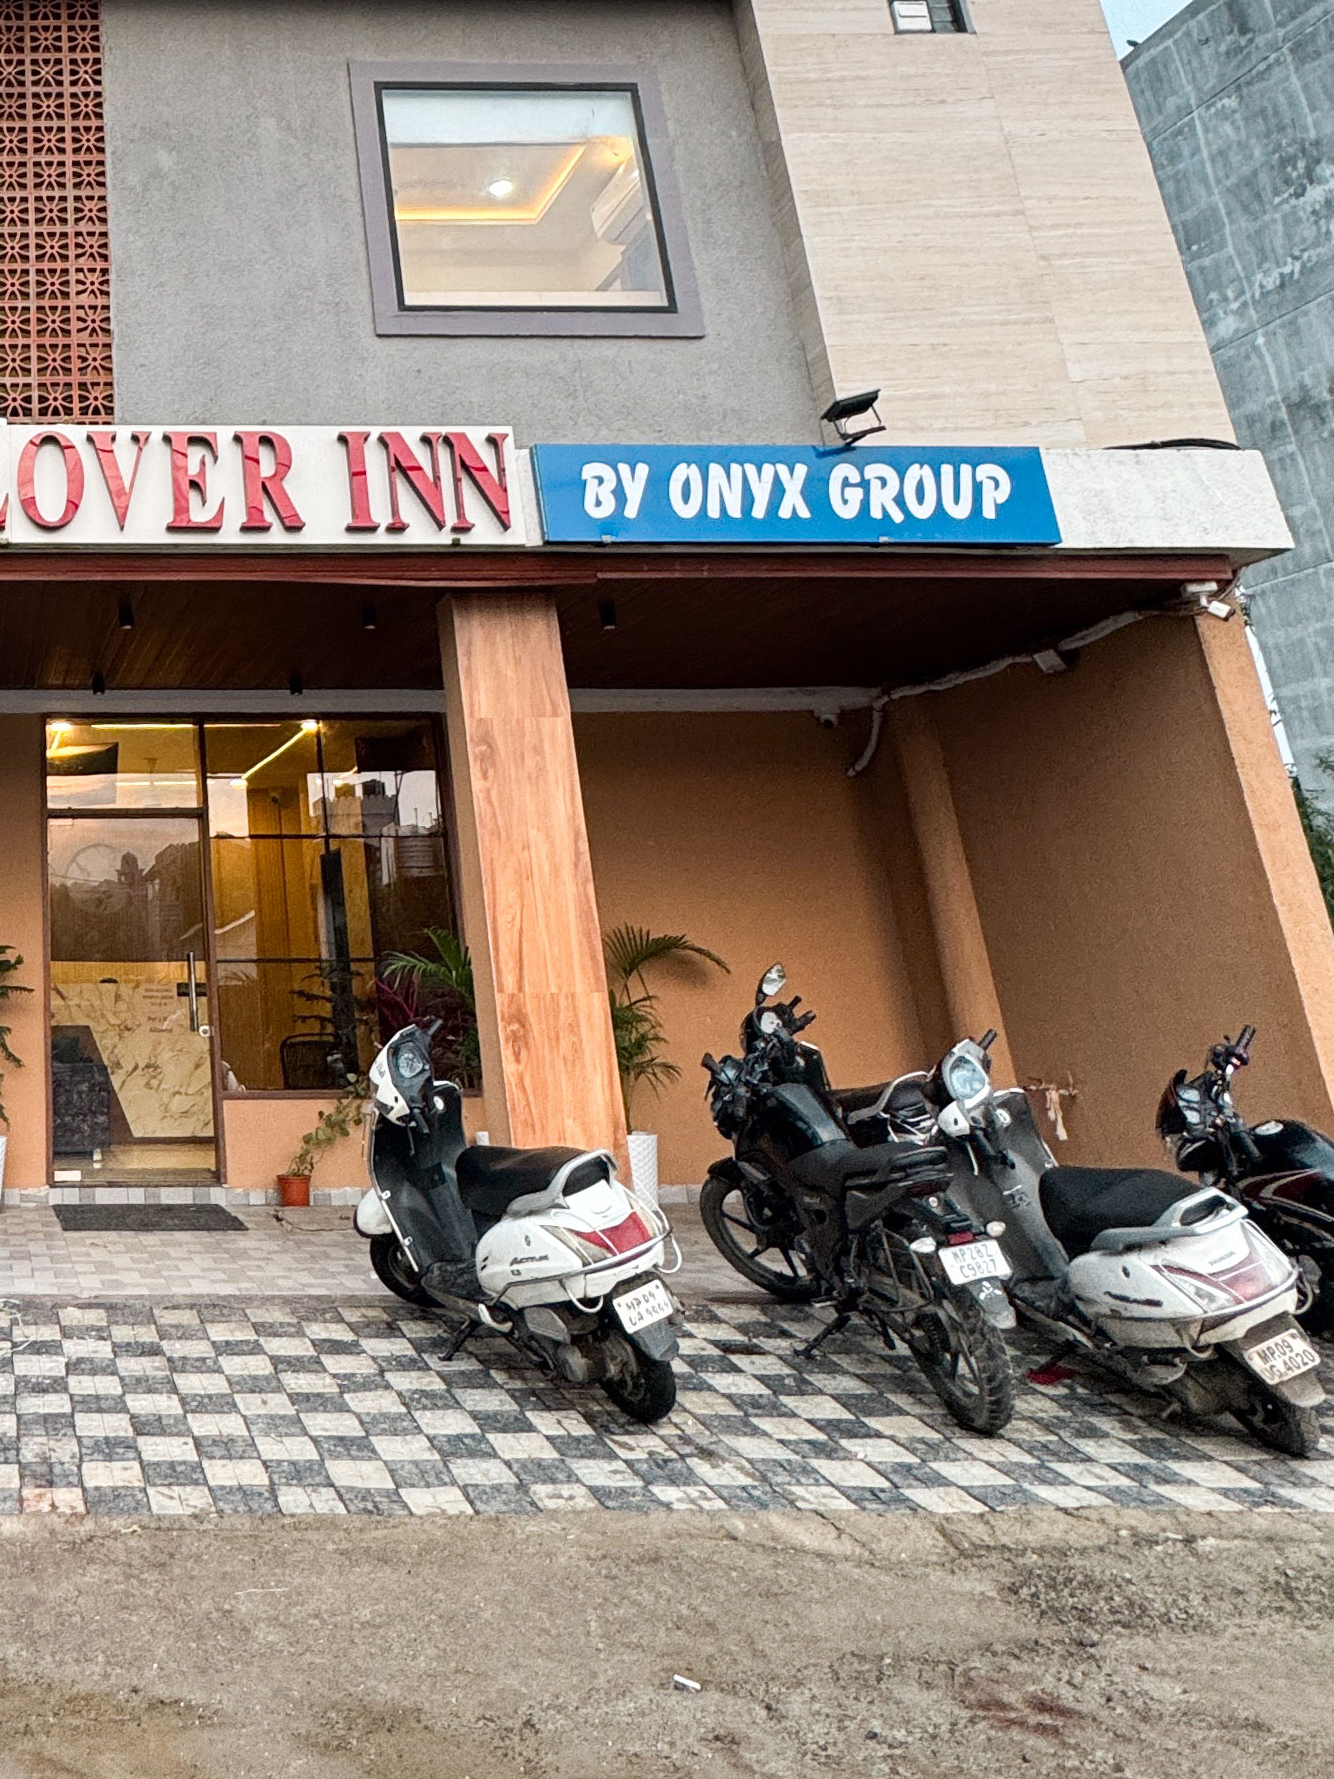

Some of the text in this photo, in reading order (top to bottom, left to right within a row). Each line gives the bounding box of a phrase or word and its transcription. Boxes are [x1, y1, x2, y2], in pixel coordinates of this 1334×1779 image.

[336, 429, 516, 535] INN
[581, 461, 1012, 524] BY ONYX GROUP
[959, 1258, 997, 1278] C9827
